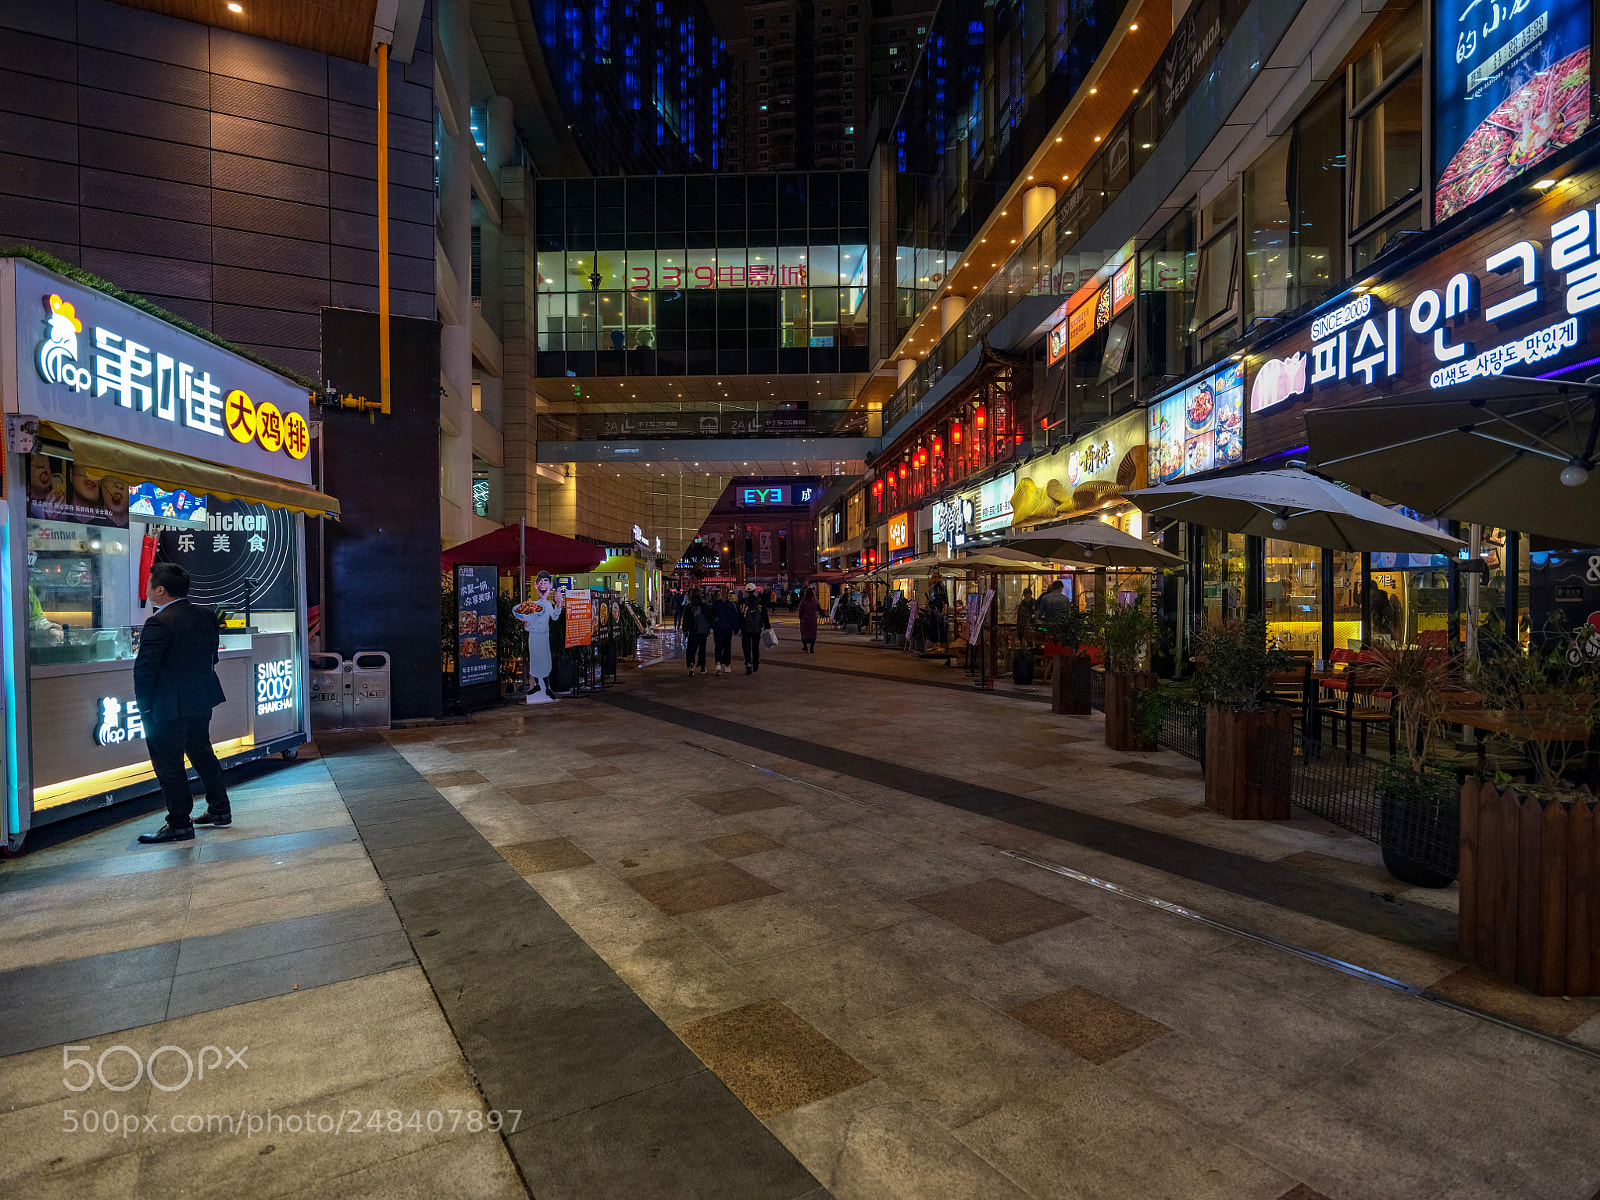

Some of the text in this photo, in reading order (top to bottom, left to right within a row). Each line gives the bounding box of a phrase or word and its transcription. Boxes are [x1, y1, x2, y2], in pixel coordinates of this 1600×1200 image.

[1165, 65, 1191, 115] SPEED
[1191, 17, 1221, 73] PANDA
[1312, 295, 1371, 340] SINCE 2003
[1477, 345, 1517, 371] 사랑도
[1526, 320, 1575, 359] 맛있게
[55, 354, 92, 393] Top
[229, 395, 307, 454] 大鸡排
[194, 511, 267, 532] hicken
[257, 659, 292, 680] SINCE
[257, 676, 292, 703] 2009
[257, 698, 292, 715] SHANGHAI
